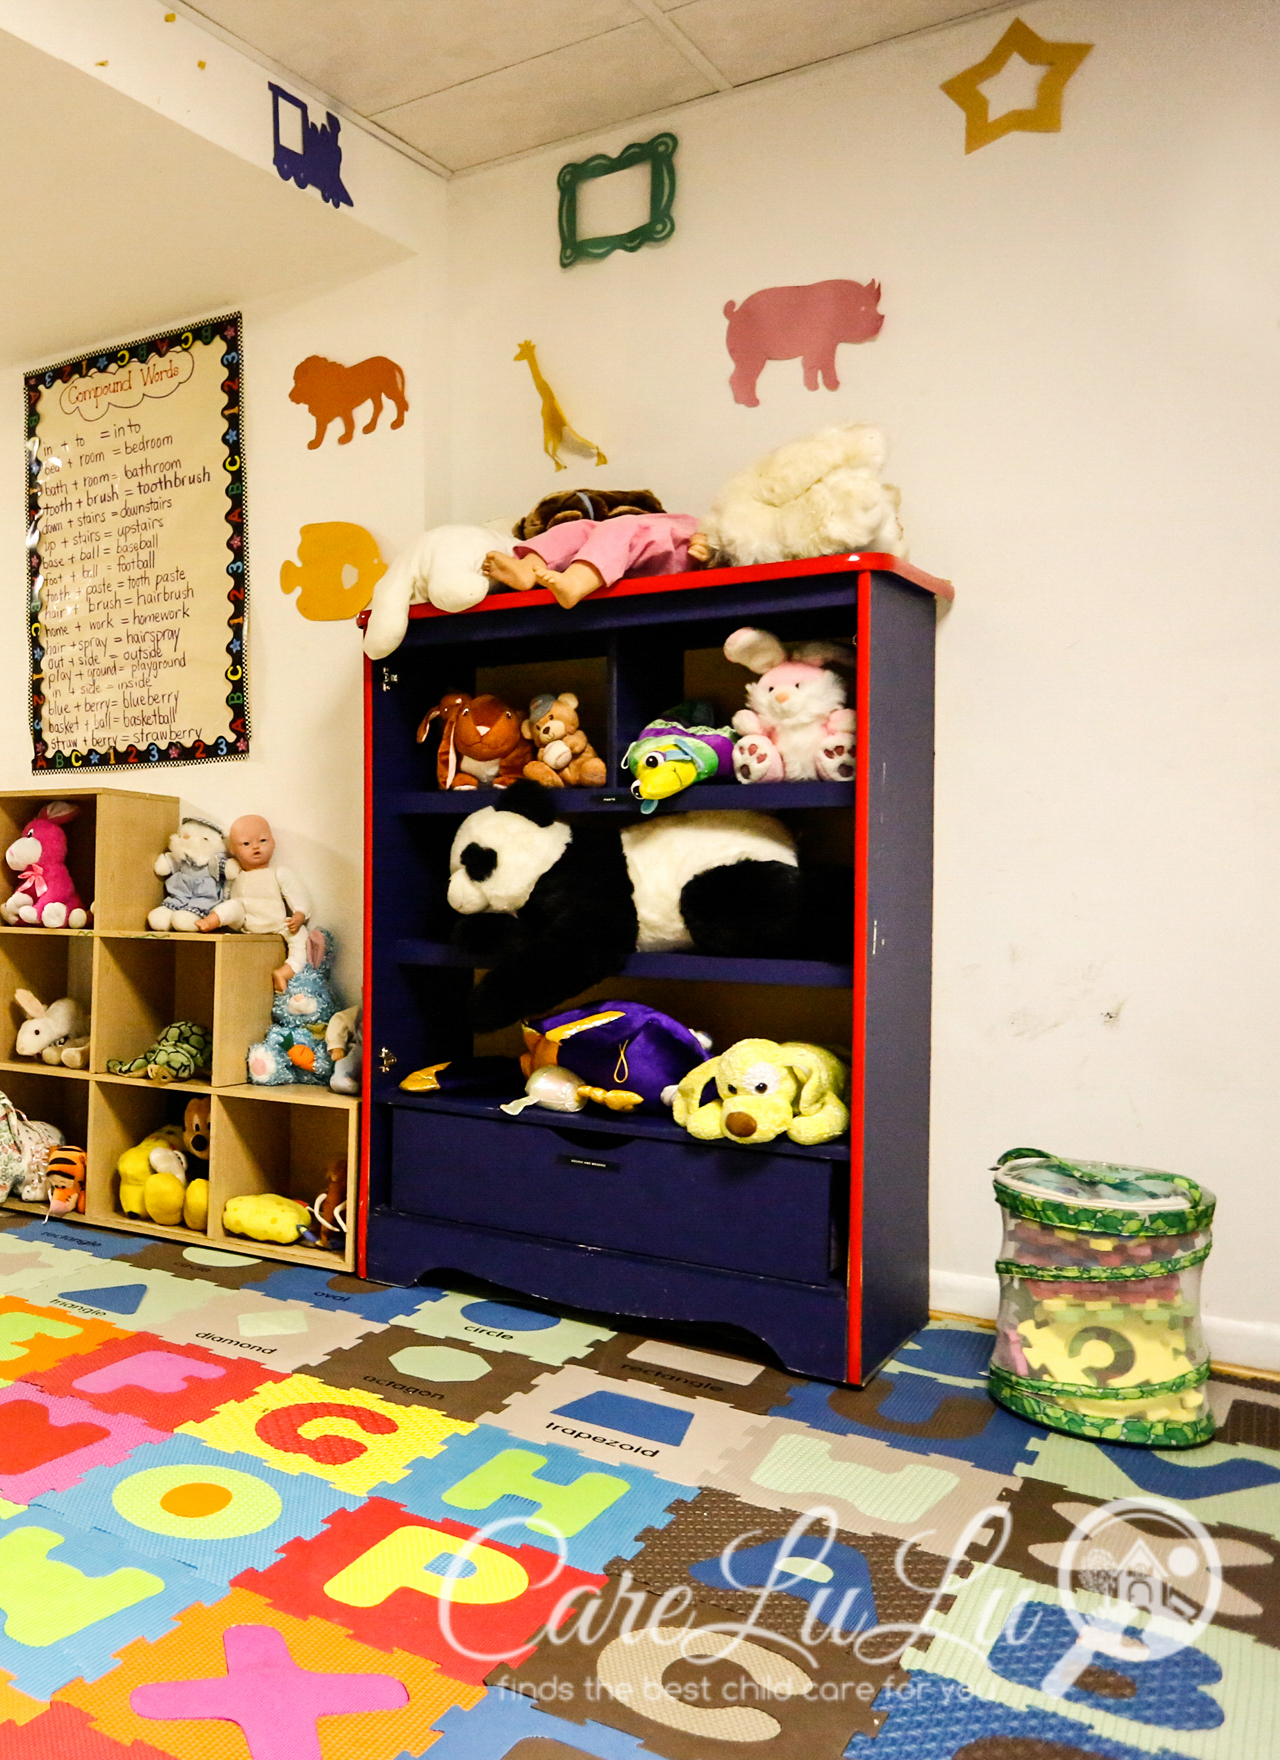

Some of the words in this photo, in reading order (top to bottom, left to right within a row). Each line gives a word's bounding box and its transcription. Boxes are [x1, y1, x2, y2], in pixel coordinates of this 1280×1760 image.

[68, 369, 133, 409] Compound
[140, 359, 180, 388] Words
[79, 451, 105, 467] room
[124, 434, 173, 455] bedroom
[43, 495, 73, 518] tooth
[86, 483, 119, 507] brush
[137, 466, 211, 495] toothbrush
[44, 480, 68, 497] bath
[83, 473, 110, 488] room
[124, 457, 182, 480] bathroom
[41, 519, 63, 535] down
[77, 511, 106, 528] stairs
[120, 497, 173, 519] downstairs
[42, 556, 65, 570] base
[79, 544, 100, 561] ball
[116, 533, 159, 555] baseball
[44, 539, 57, 557] up
[72, 530, 101, 546] stairs
[116, 516, 164, 543] upstairs
[43, 572, 63, 587] foot
[117, 550, 155, 573] football
[85, 577, 113, 601] paste
[88, 591, 121, 614] brush
[136, 580, 195, 607] hairbrush
[44, 625, 70, 638] home
[89, 612, 115, 630] work
[133, 603, 191, 626] homework
[48, 655, 65, 670] out
[78, 652, 101, 666] side
[123, 646, 163, 662] outside
[78, 634, 108, 657] spray
[126, 627, 181, 653] hairspray
[48, 668, 72, 690] play
[86, 659, 117, 684] ground
[131, 651, 187, 679] playground
[52, 688, 62, 698] in
[117, 676, 153, 690] inside
[48, 700, 71, 716] blue
[84, 697, 111, 714] berry
[122, 689, 180, 716] blueberry
[48, 713, 80, 734] basket
[122, 705, 176, 728] basketball
[50, 735, 78, 750] straw
[133, 727, 203, 745] strawberry
[49, 1298, 108, 1317] triangle
[194, 1330, 278, 1356] diamond
[464, 1324, 515, 1341] circle
[620, 1362, 724, 1393] rectangle
[544, 1421, 660, 1459] trapezoid
[255, 1402, 399, 1465] G
[441, 1449, 630, 1537] H
[112, 1464, 283, 1540] O
[323, 1525, 529, 1607] P
[129, 1623, 410, 1760] X
